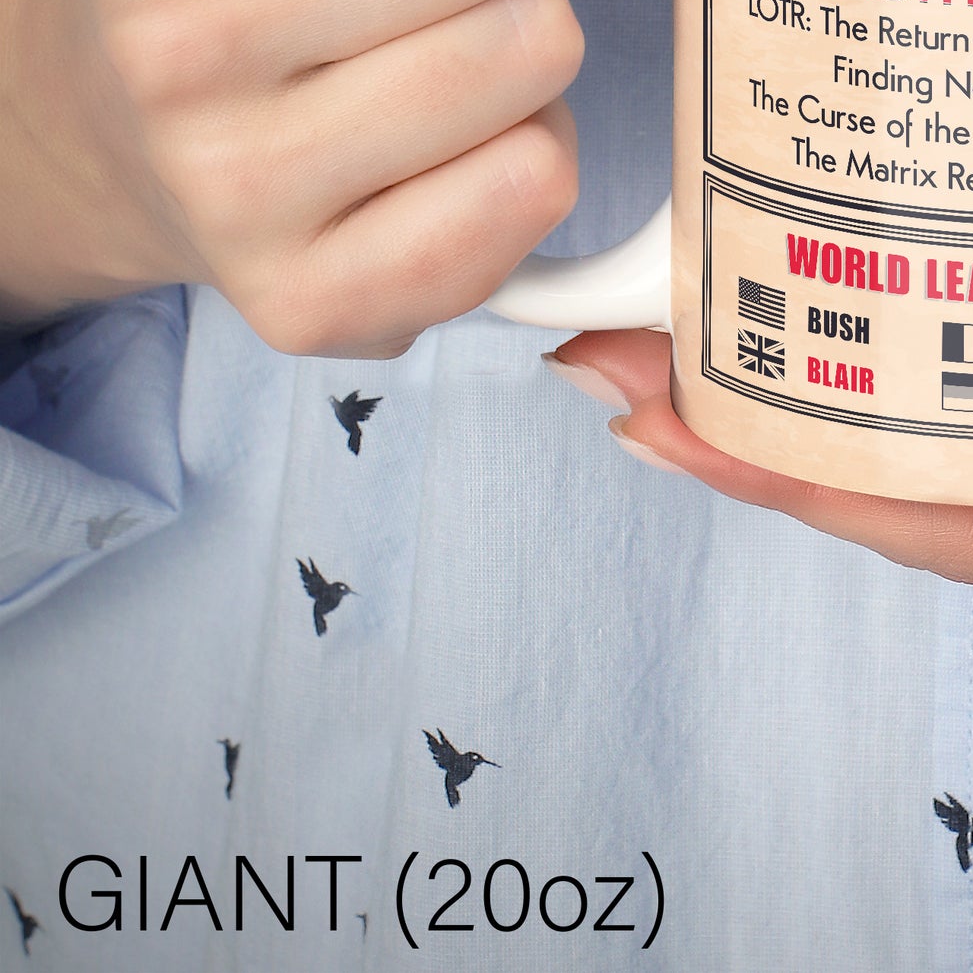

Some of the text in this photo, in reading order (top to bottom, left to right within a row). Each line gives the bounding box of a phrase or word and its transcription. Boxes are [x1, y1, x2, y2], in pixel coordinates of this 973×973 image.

[820, 7, 868, 42] The
[878, 16, 969, 53] Return
[833, 55, 933, 104] Finding
[749, 79, 789, 116] The
[798, 94, 876, 134] Curse
[886, 108, 914, 147] of
[925, 112, 970, 145] the
[792, 136, 837, 173] The
[846, 149, 938, 188] Matrix
[786, 233, 910, 296] WORLD
[807, 306, 870, 345] BUSH
[807, 356, 874, 395] BLAIR
